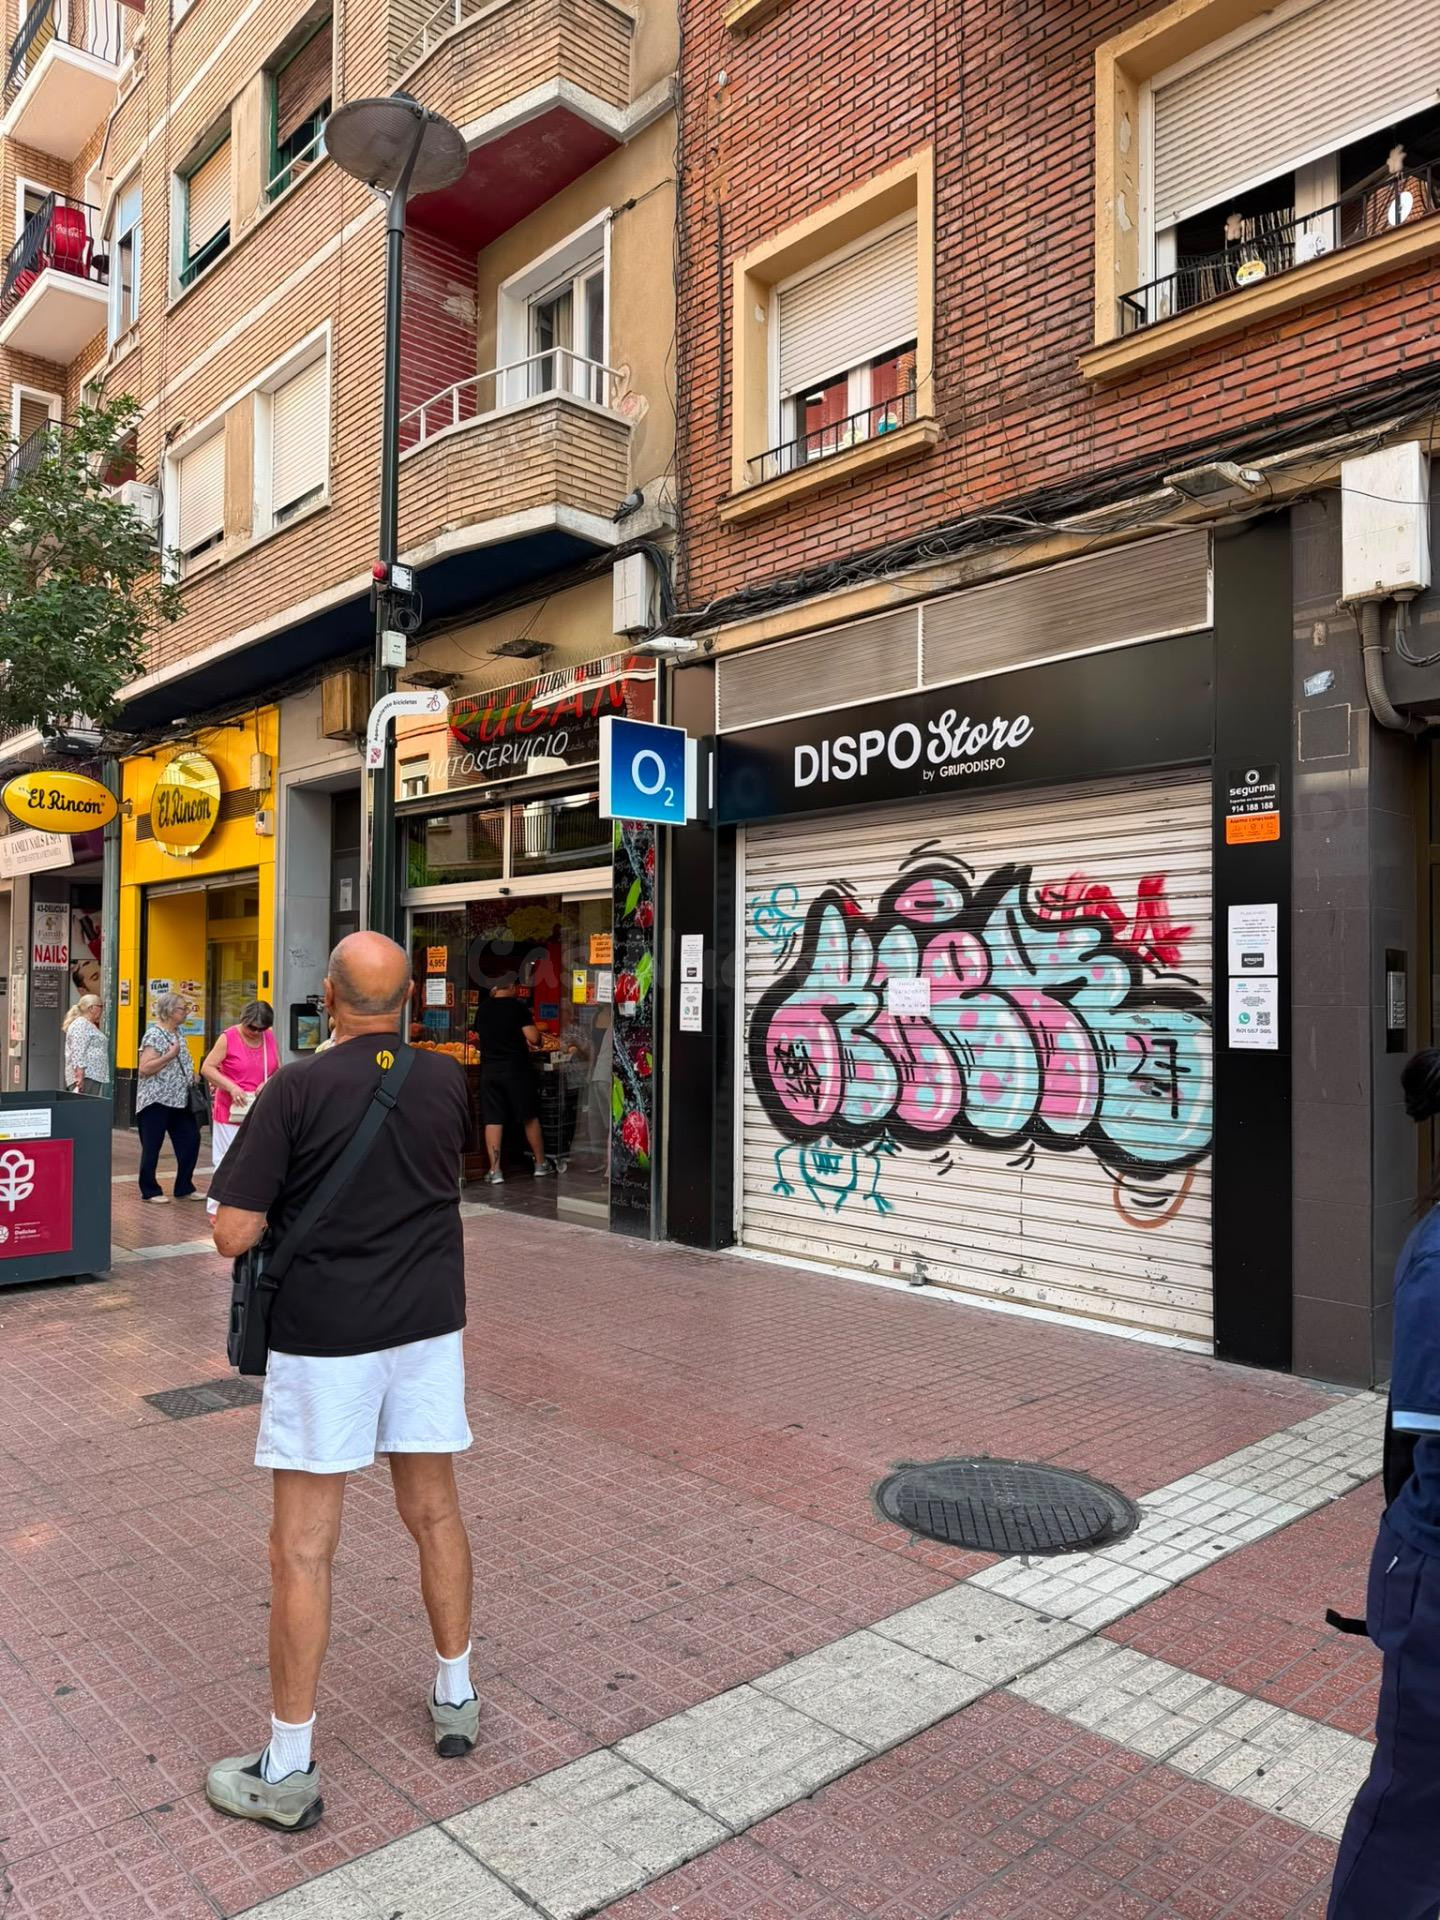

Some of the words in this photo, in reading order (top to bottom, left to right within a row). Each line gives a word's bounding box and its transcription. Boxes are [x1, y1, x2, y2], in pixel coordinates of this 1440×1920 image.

[425, 731, 569, 782] AUTOSERVICIO
[794, 722, 922, 788] DISPO
[927, 708, 1035, 764] Store
[922, 768, 935, 782] by
[939, 757, 1006, 778] GRUPODISPO
[1229, 784, 1275, 796] segurma
[157, 790, 170, 828] El
[1231, 804, 1244, 813] 914
[34, 944, 68, 964] NAILS
